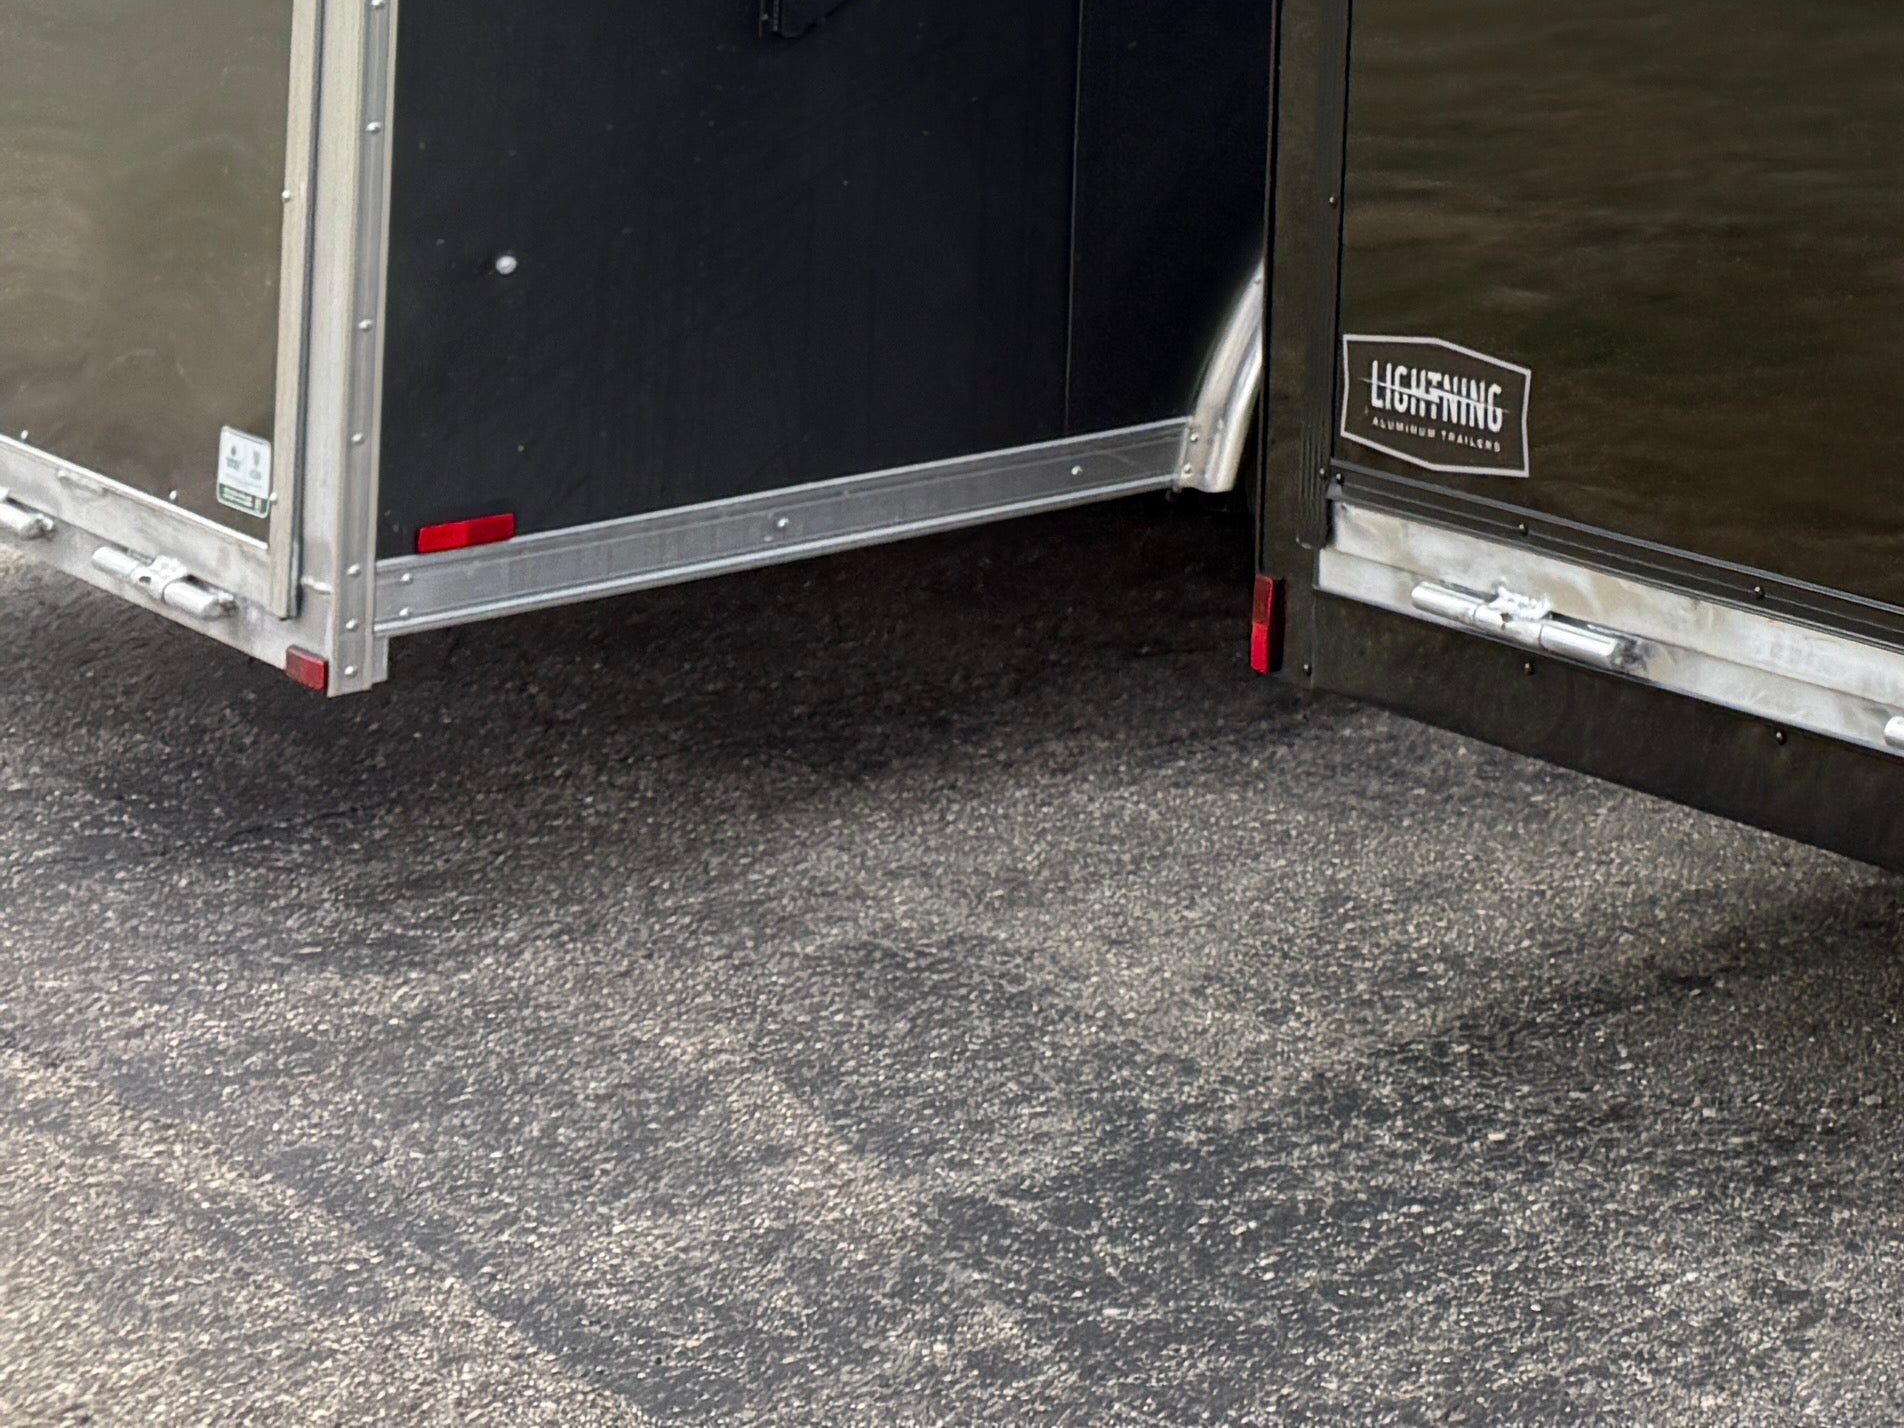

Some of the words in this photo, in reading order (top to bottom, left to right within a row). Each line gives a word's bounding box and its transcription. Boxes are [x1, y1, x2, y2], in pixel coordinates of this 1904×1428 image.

[1371, 360, 1503, 433] LIGHTNING
[1372, 416, 1436, 438] ALUMINUM
[1441, 430, 1501, 453] TRAILERS
